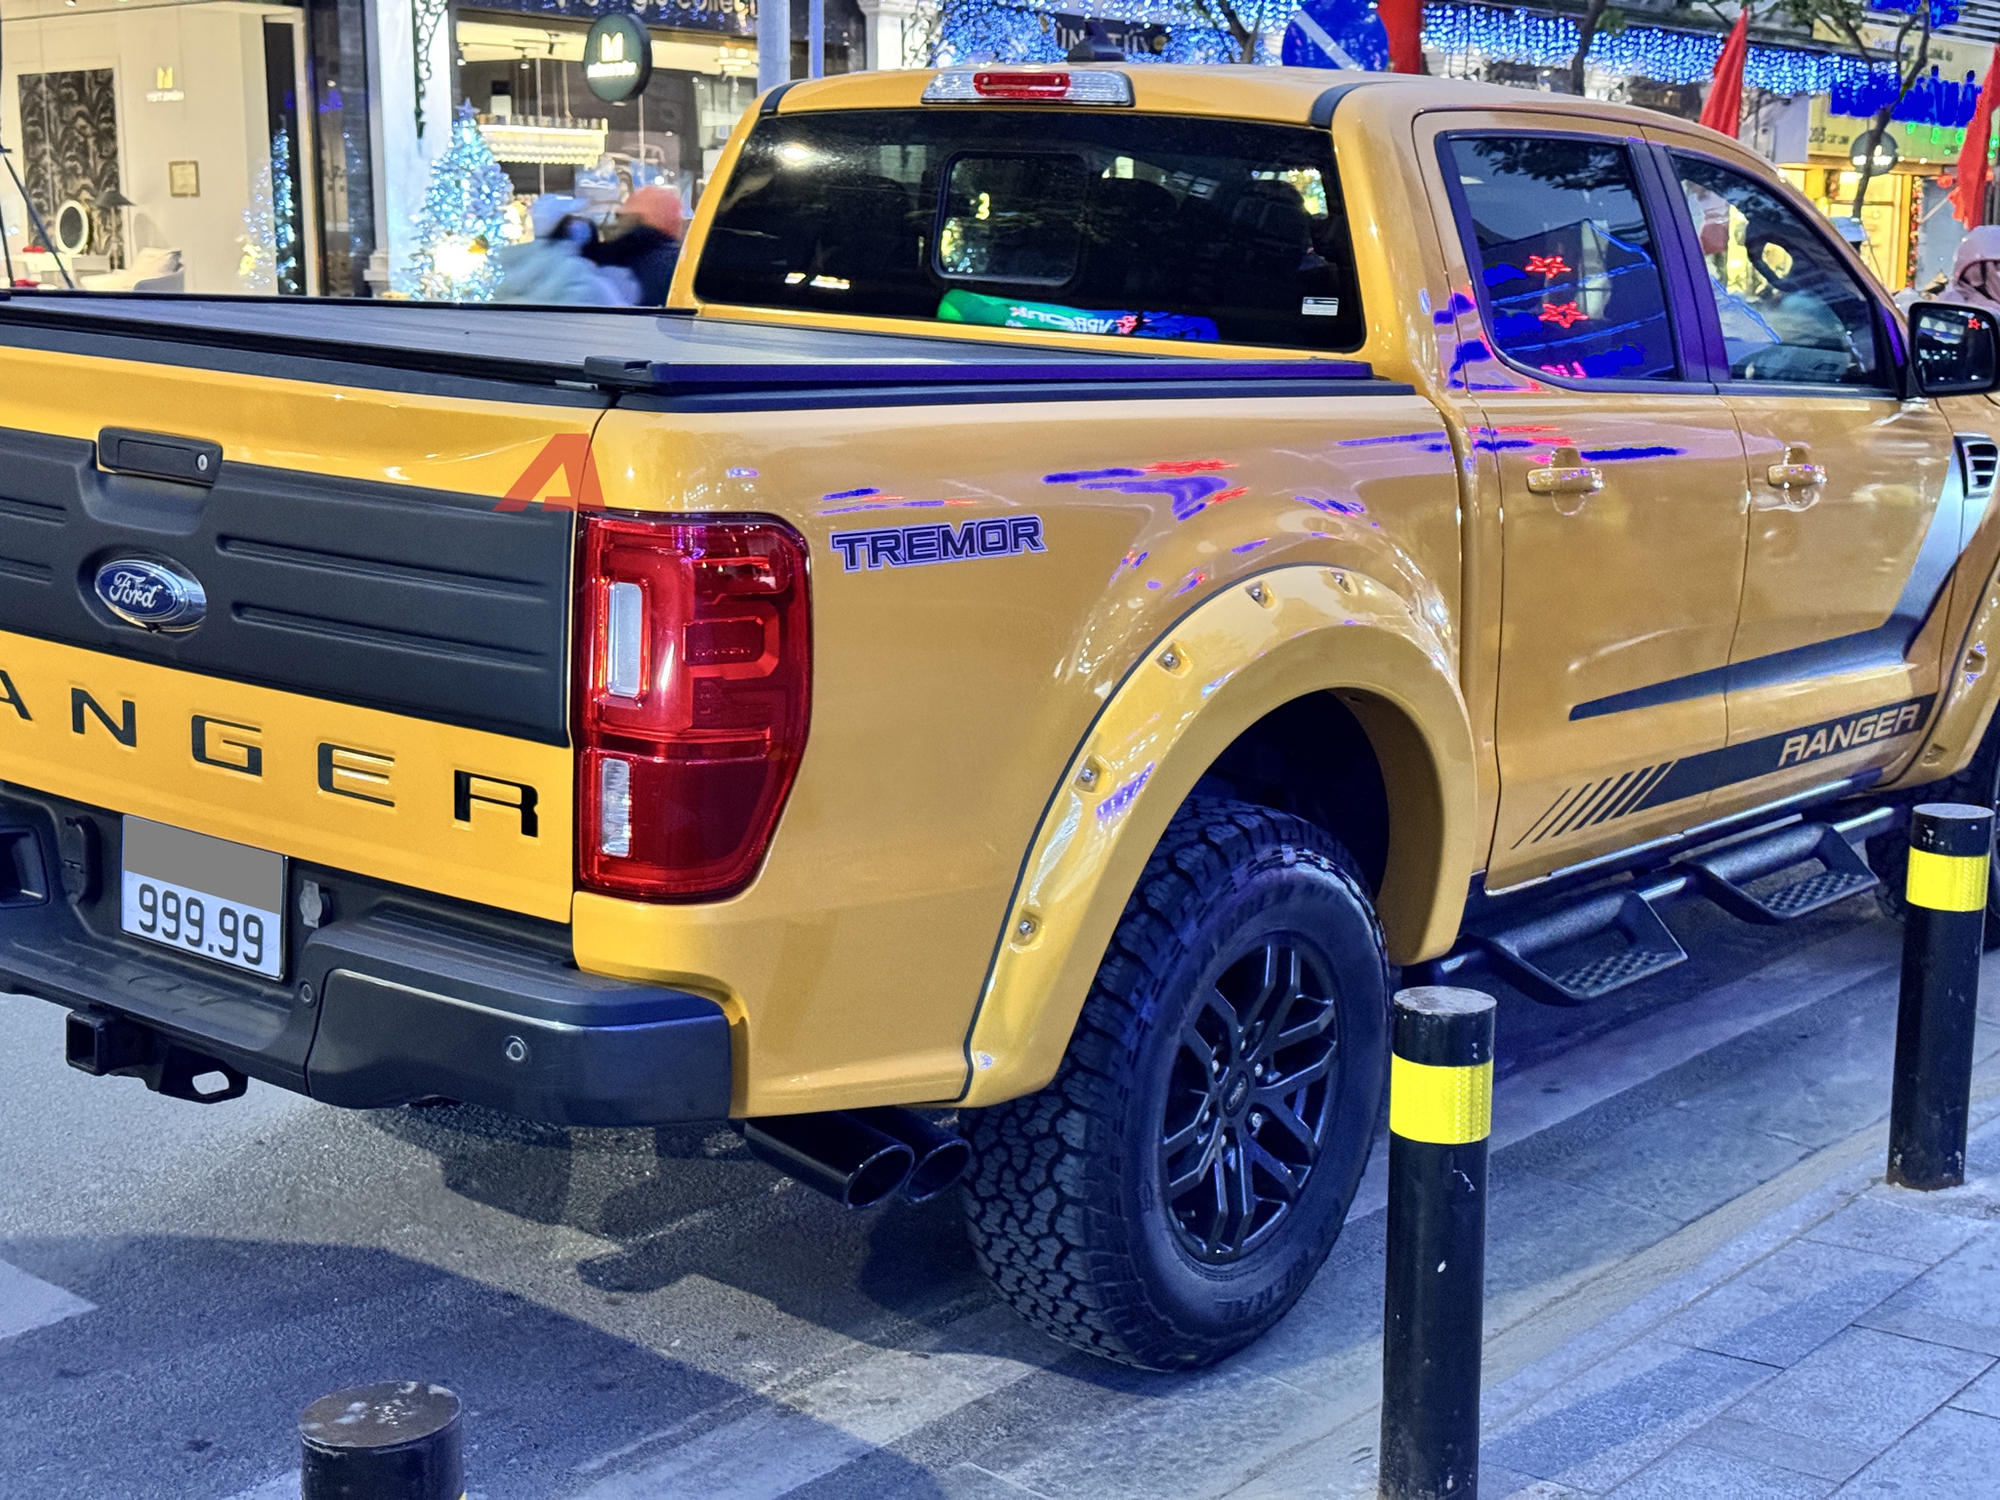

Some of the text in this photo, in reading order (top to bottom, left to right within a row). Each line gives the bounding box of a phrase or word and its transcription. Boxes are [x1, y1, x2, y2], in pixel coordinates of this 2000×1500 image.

[829, 514, 1048, 574] TREMOR
[109, 571, 163, 609] Ford
[1778, 703, 1921, 767] RANGER
[138, 883, 264, 966] 999.99
